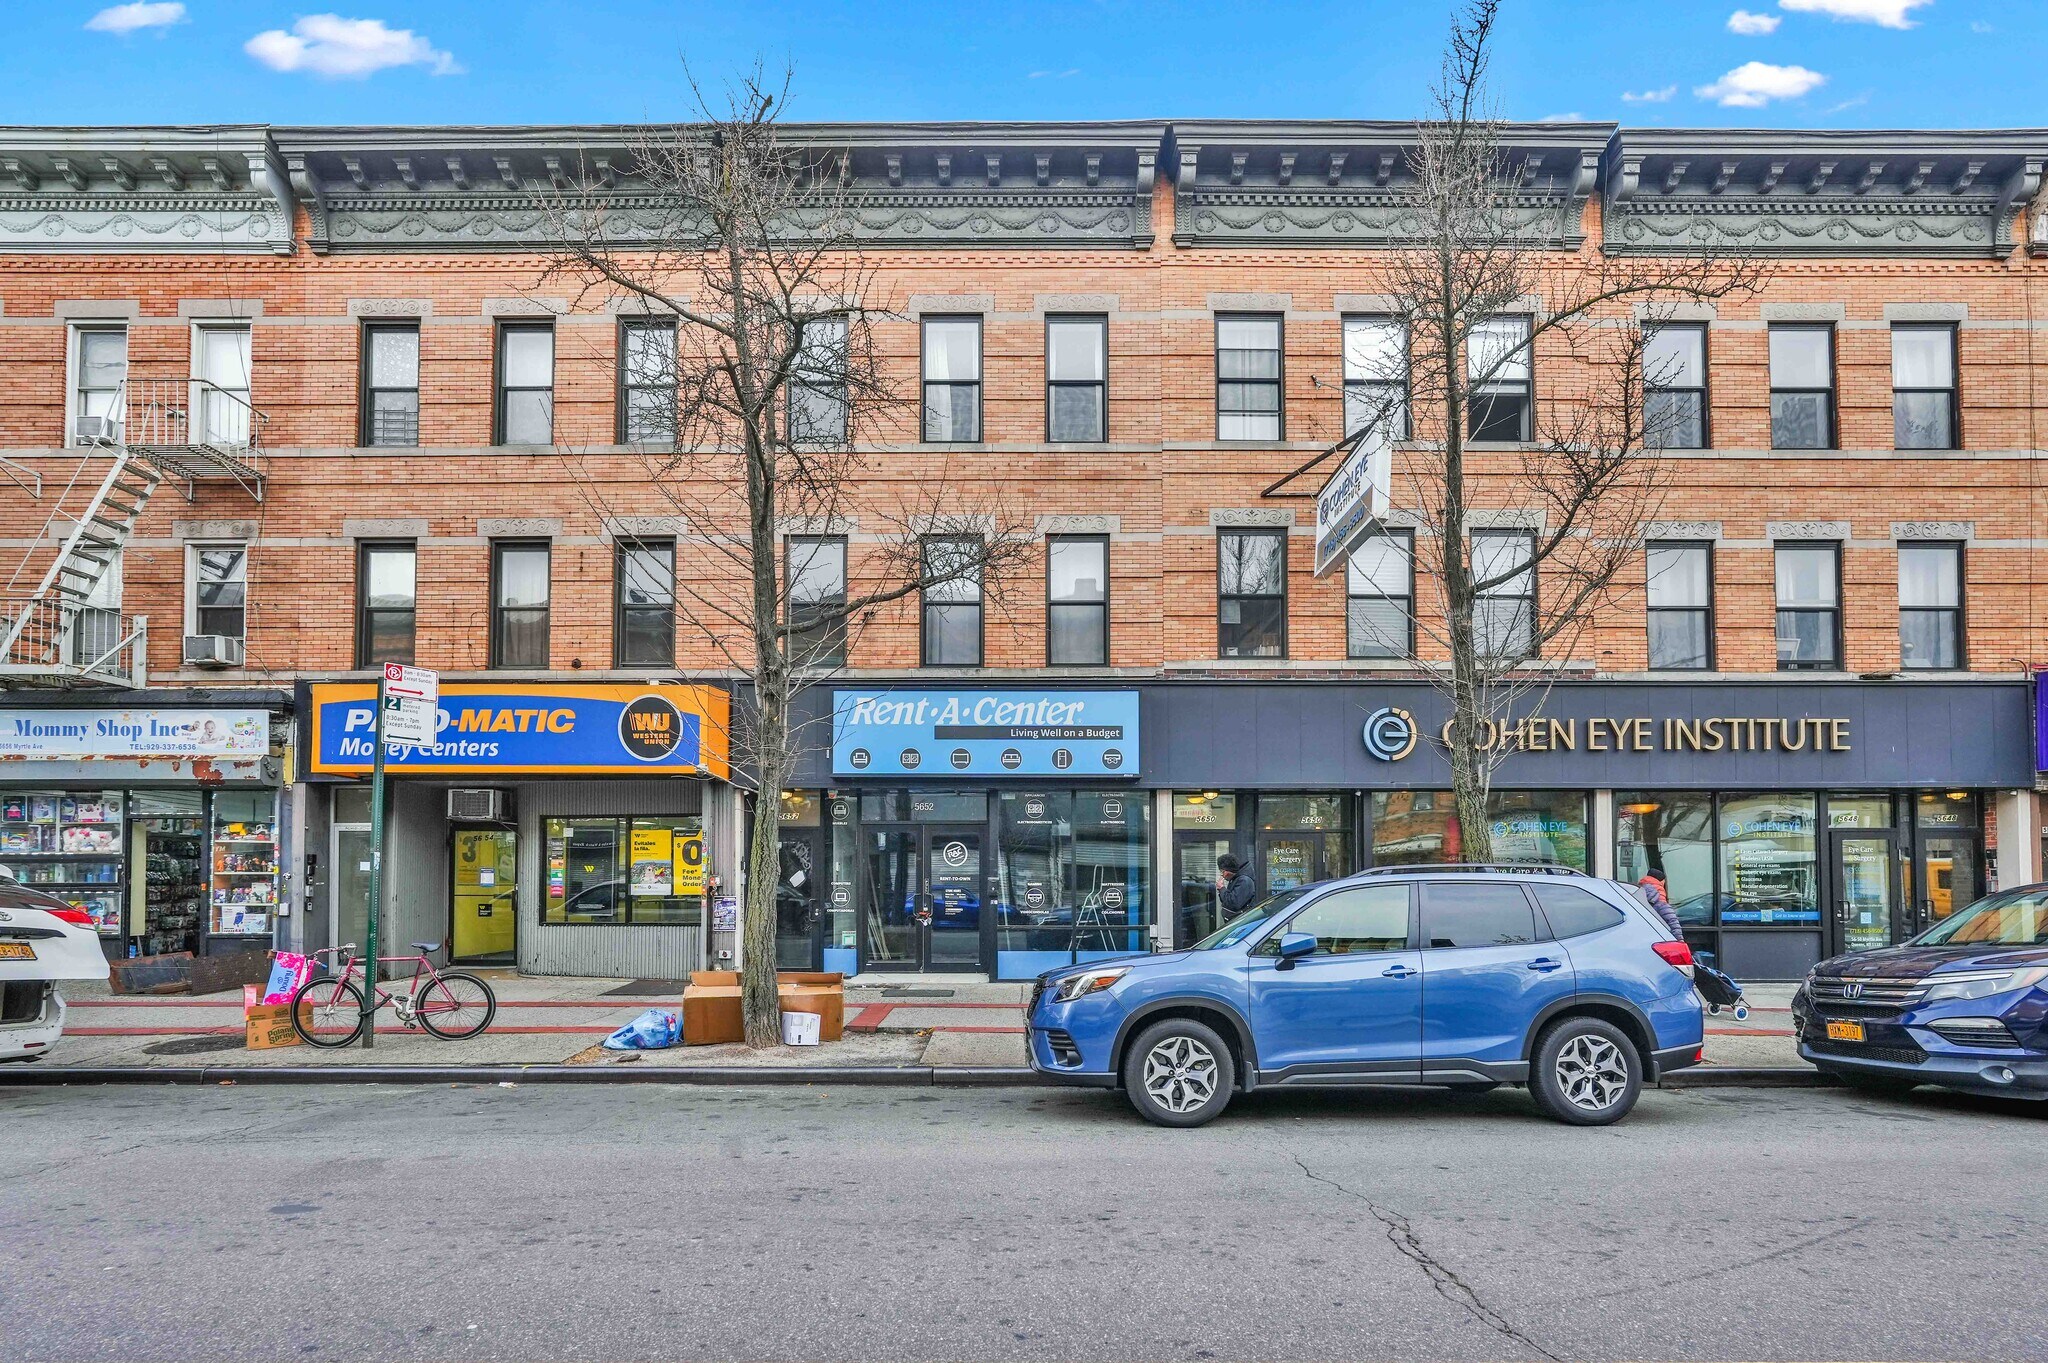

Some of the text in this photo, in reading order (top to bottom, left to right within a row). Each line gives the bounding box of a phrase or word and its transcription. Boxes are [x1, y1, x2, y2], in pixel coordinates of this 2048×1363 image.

[1330, 454, 1369, 512] COHEN EYE
[1334, 482, 1361, 517] INSTITUTE
[388, 698, 397, 709] 2
[14, 718, 180, 741] Mommy Shop Inc
[1010, 728, 1039, 738] Living
[1041, 728, 1062, 737] Well
[1086, 728, 1120, 738] Budget
[1587, 718, 1653, 750] EYE
[1663, 718, 1851, 750] INSTITUTE
[914, 802, 934, 811] 5652
[1511, 822, 1567, 832] COHEN EYE
[1745, 822, 1800, 831] COHEN EYE
[279, 970, 294, 992] Downy
[268, 1027, 294, 1038] Poland
[269, 1032, 295, 1044] Spring
